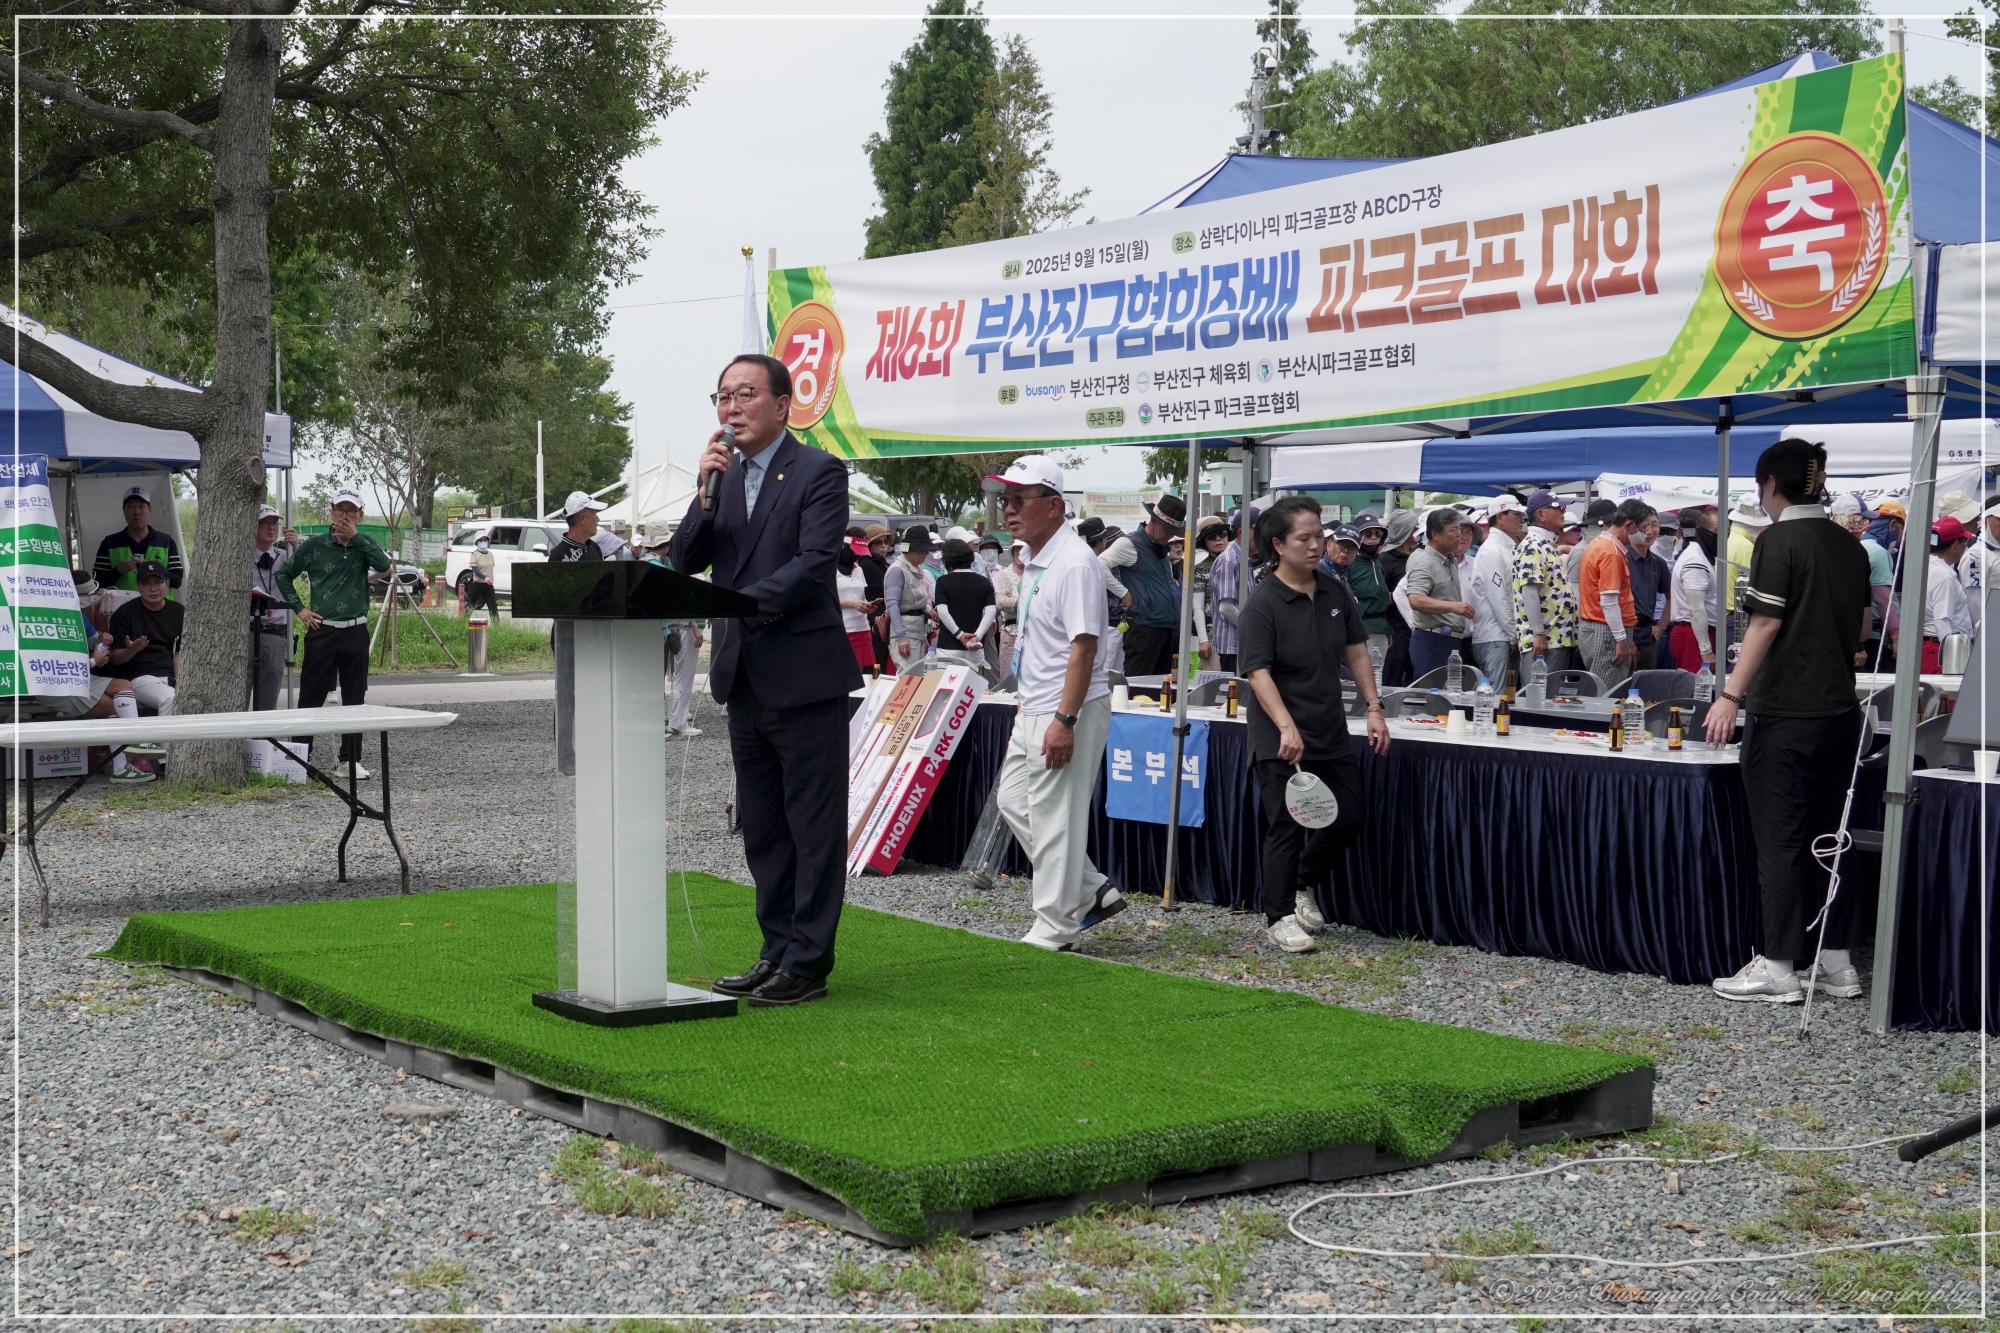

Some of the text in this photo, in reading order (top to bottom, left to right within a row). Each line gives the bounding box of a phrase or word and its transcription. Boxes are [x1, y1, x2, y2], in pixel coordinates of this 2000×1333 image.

[1175, 184, 1443, 251] 장소 삼락다이나믹 파크골프장 ABCD구장
[1759, 174, 1845, 292] 축
[865, 184, 1661, 383] 제6회 부산진구협회장배 파크골프 대회
[1004, 239, 1149, 278] 일시 2025년 9월 15일(월)
[787, 328, 826, 405] 경
[1000, 343, 1416, 402] 후원 busanjin 부산진구청 부산진구 체육회 부산시파크골프협회
[1158, 398, 1212, 424] 부산진구
[1214, 390, 1300, 420] 파크골프협회
[25, 576, 72, 588] PHOENIX
[29, 659, 89, 678] 하이눈안경
[880, 685, 976, 859] PHOENIX PARK GOLF
